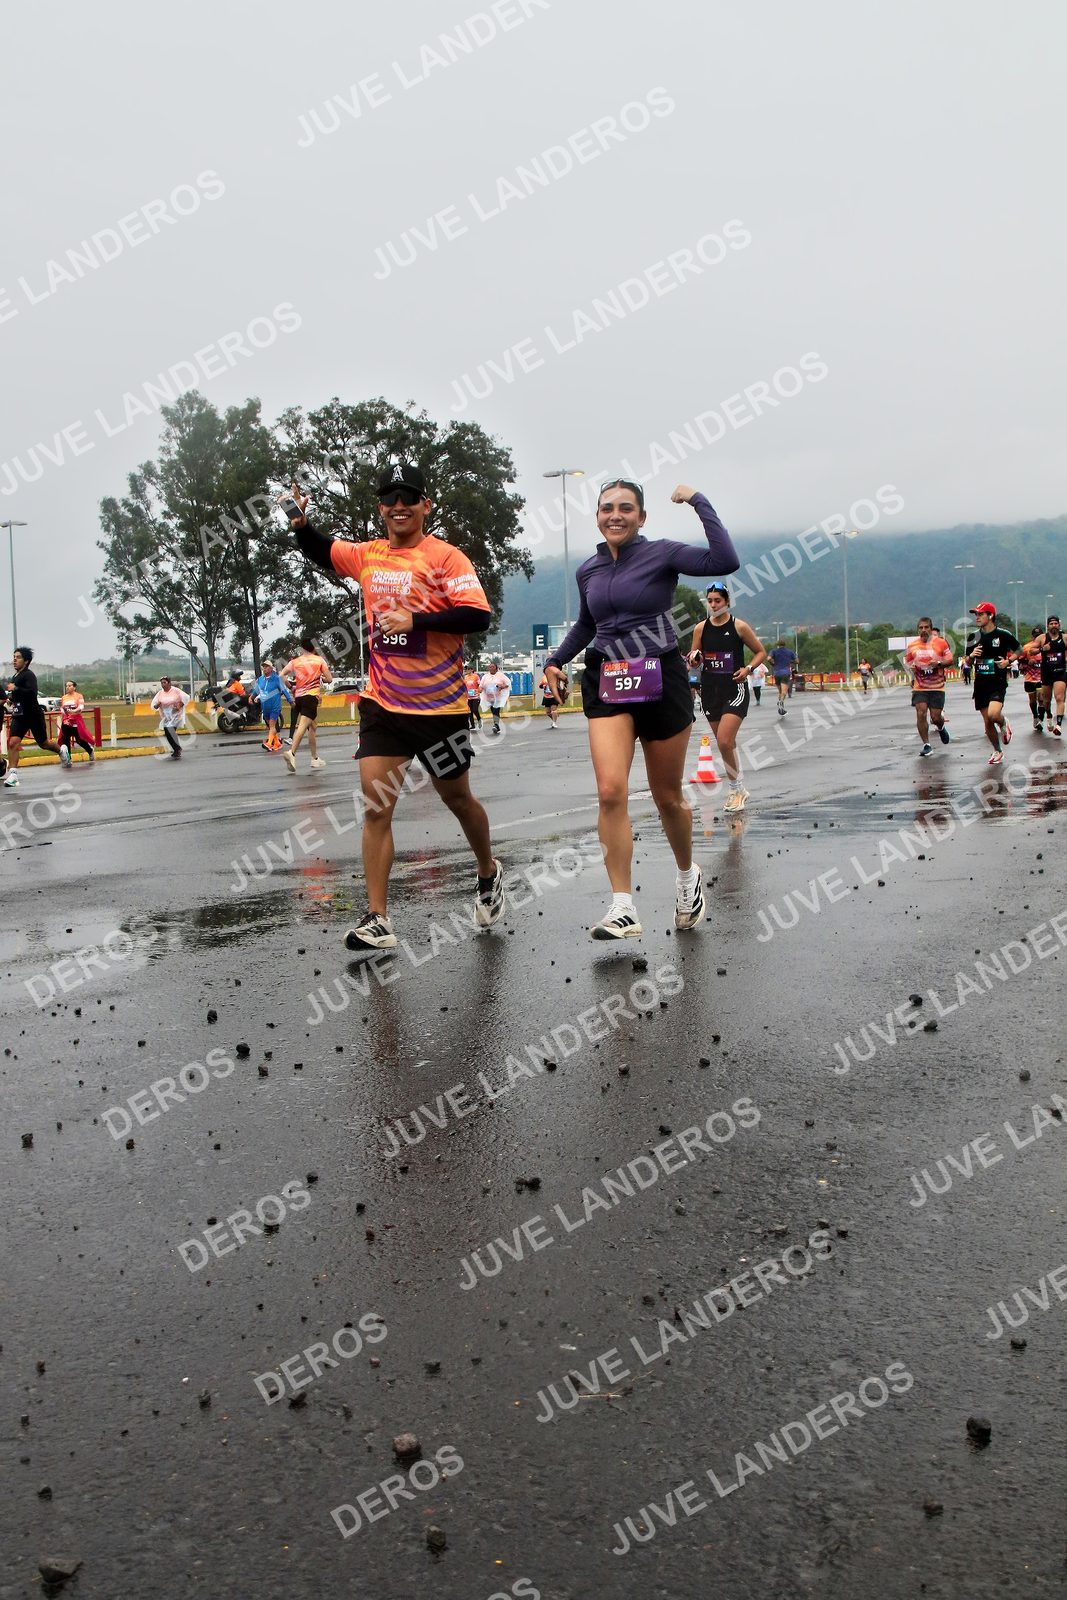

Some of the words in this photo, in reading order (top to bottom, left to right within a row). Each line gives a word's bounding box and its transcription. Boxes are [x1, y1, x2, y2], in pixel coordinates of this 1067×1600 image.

[382, 633, 408, 646] 596
[536, 635, 544, 646] E
[615, 676, 642, 691] 597
